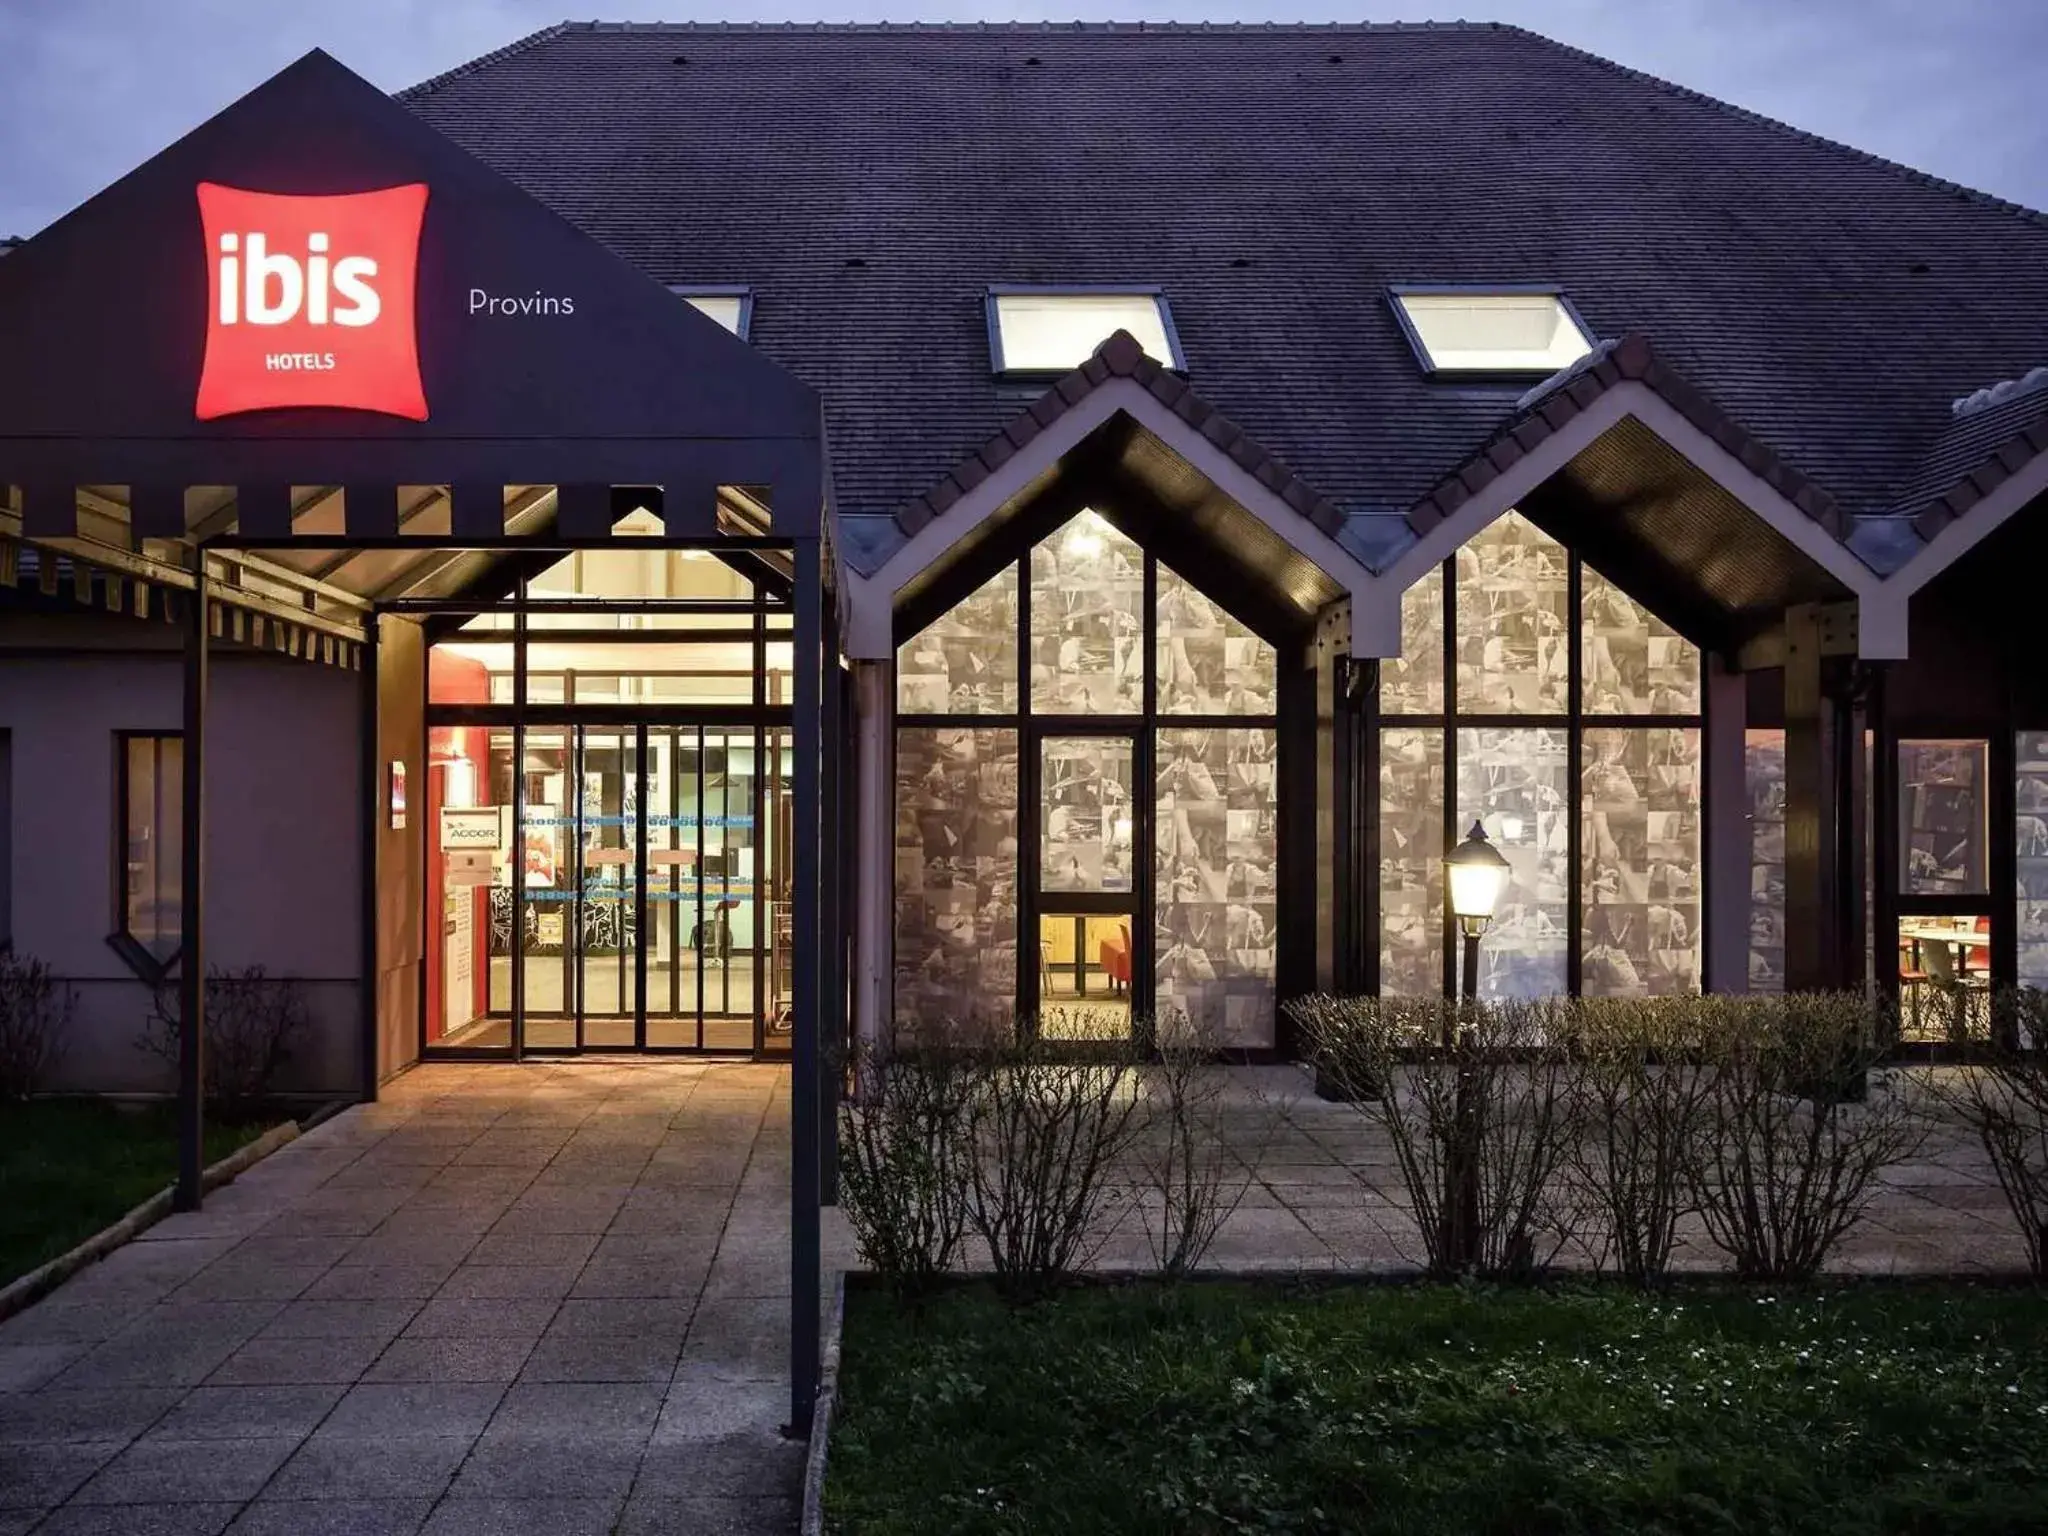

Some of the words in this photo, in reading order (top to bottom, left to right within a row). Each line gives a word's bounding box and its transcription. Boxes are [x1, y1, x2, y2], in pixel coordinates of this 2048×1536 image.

[219, 232, 381, 327] ibis
[469, 289, 575, 316] Provins
[265, 353, 335, 371] HOTELS
[451, 829, 496, 838] ACCOR
